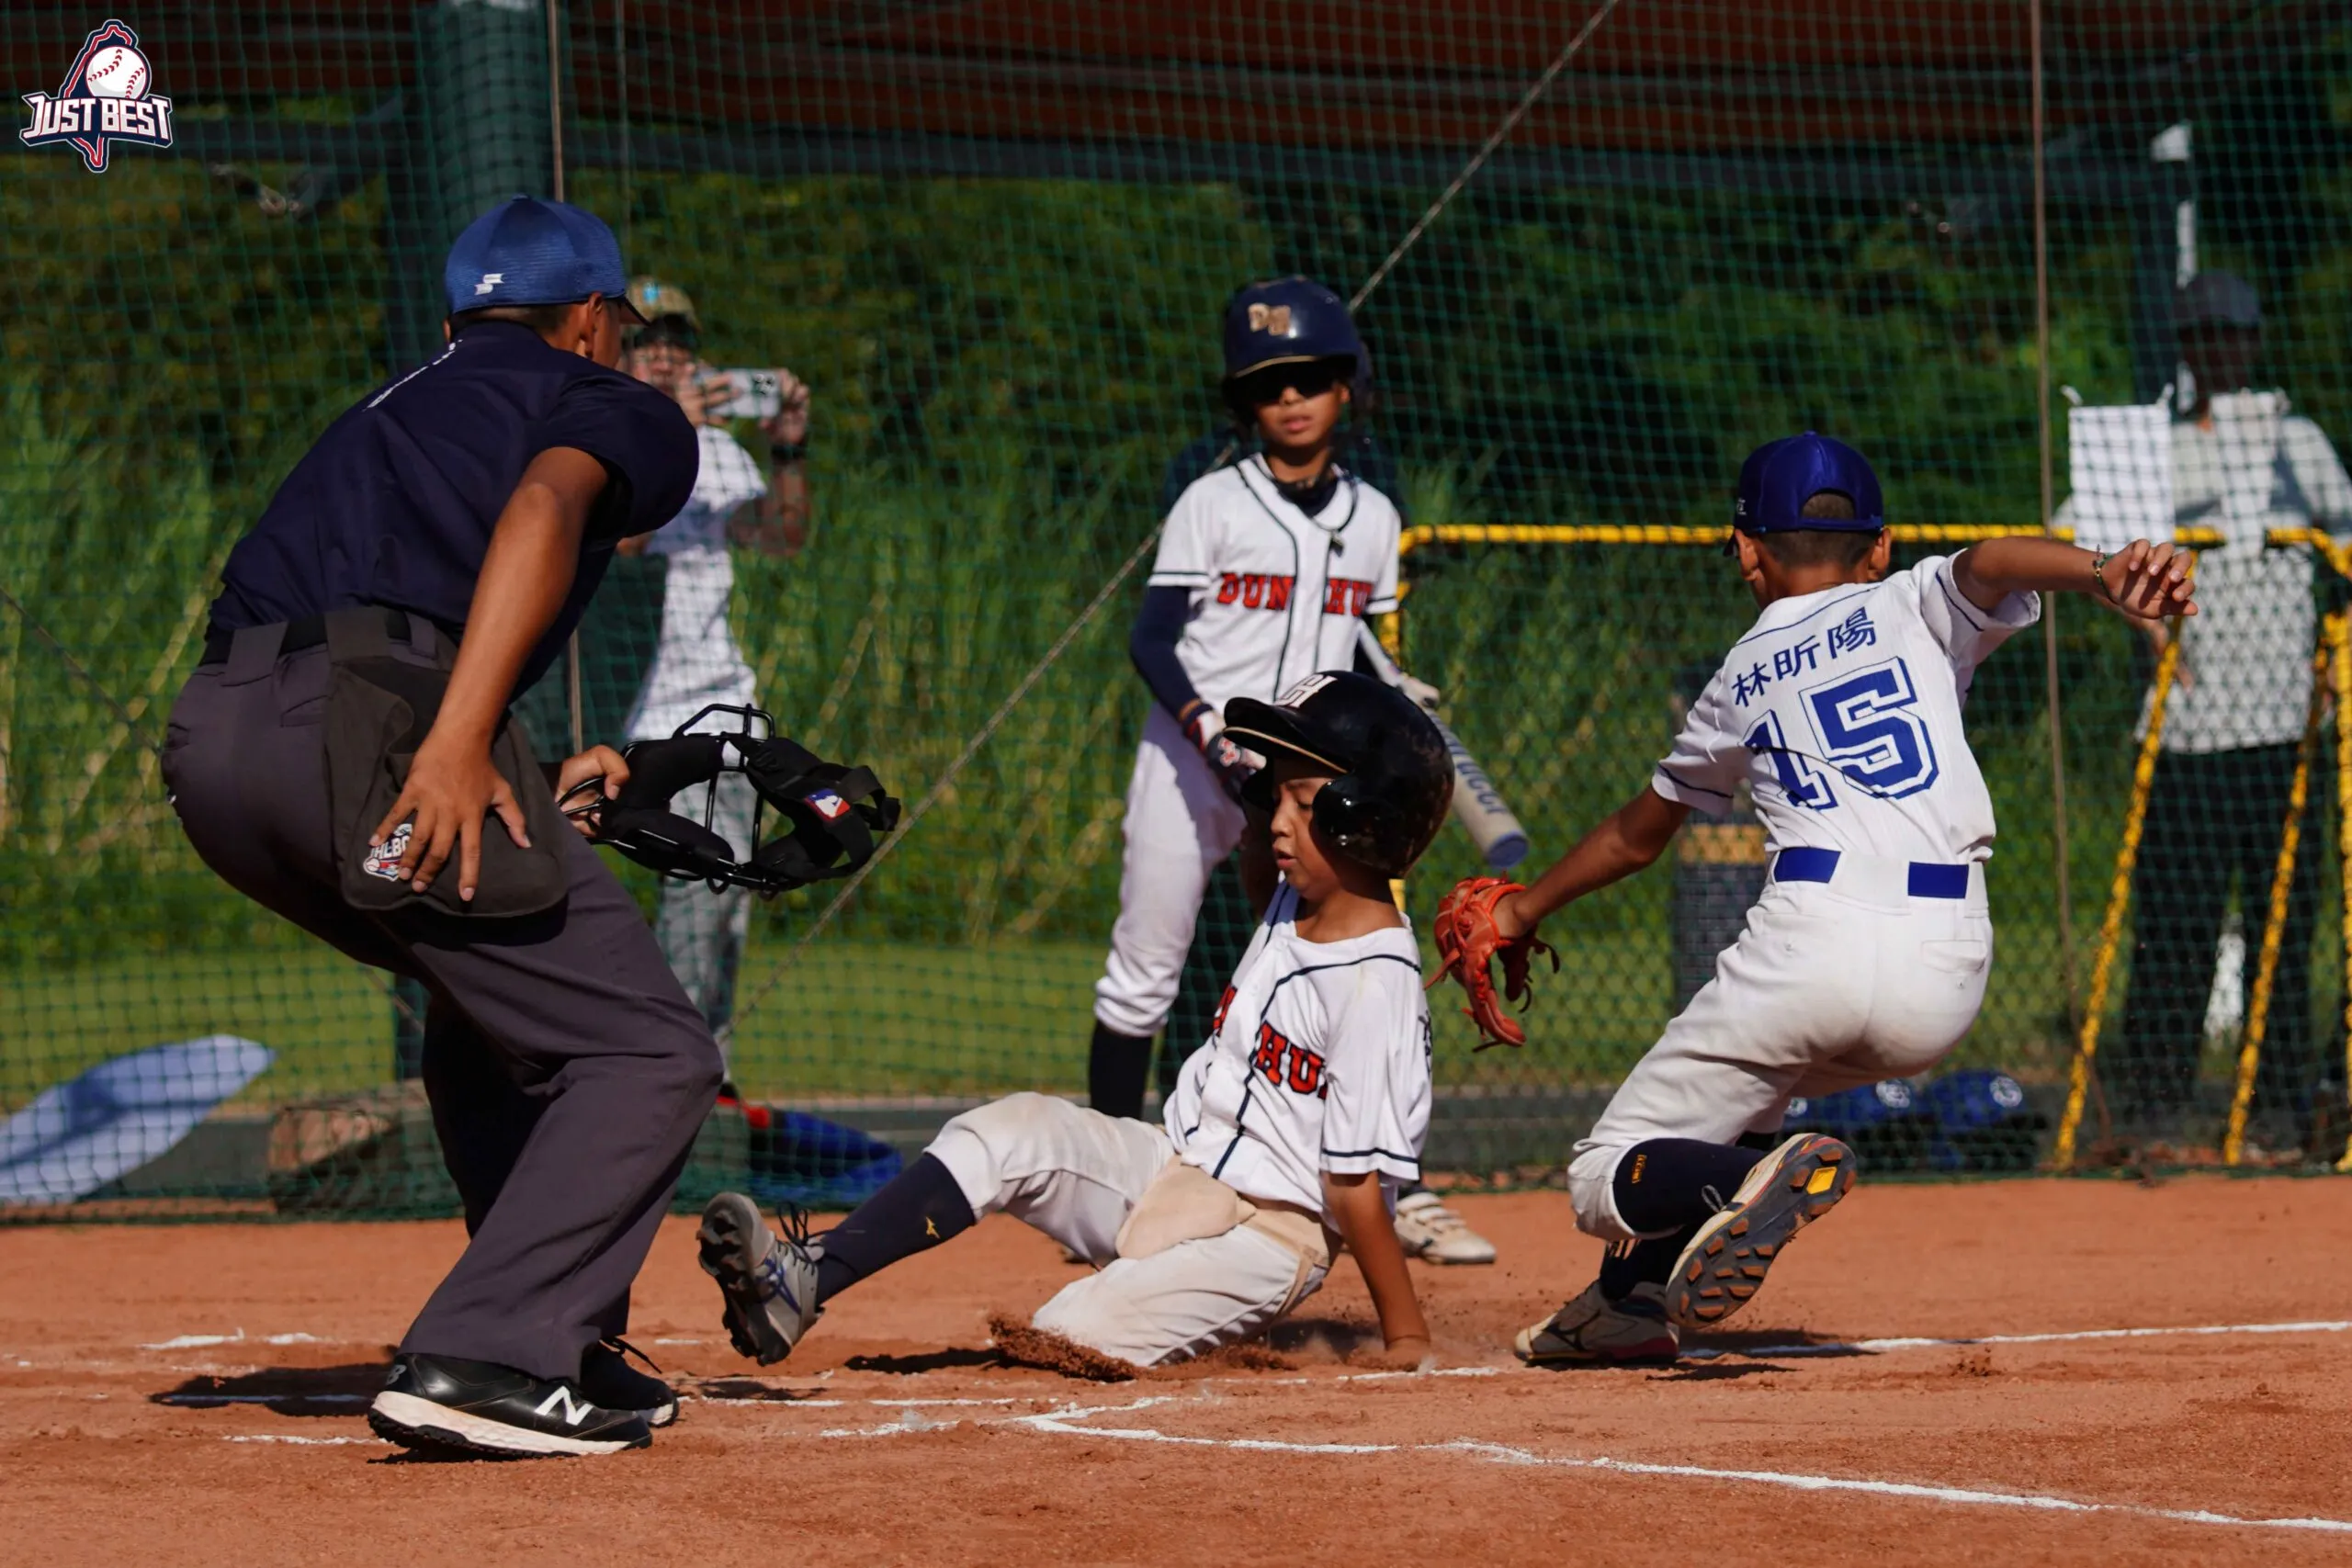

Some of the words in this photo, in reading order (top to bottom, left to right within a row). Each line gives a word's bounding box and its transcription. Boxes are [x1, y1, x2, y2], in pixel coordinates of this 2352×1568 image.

[1217, 572, 1295, 611] DUN
[1731, 606, 1877, 708] 林昕陽
[1739, 656, 1939, 810] 15
[1255, 1020, 1329, 1100] HU
[535, 1385, 595, 1426] N
